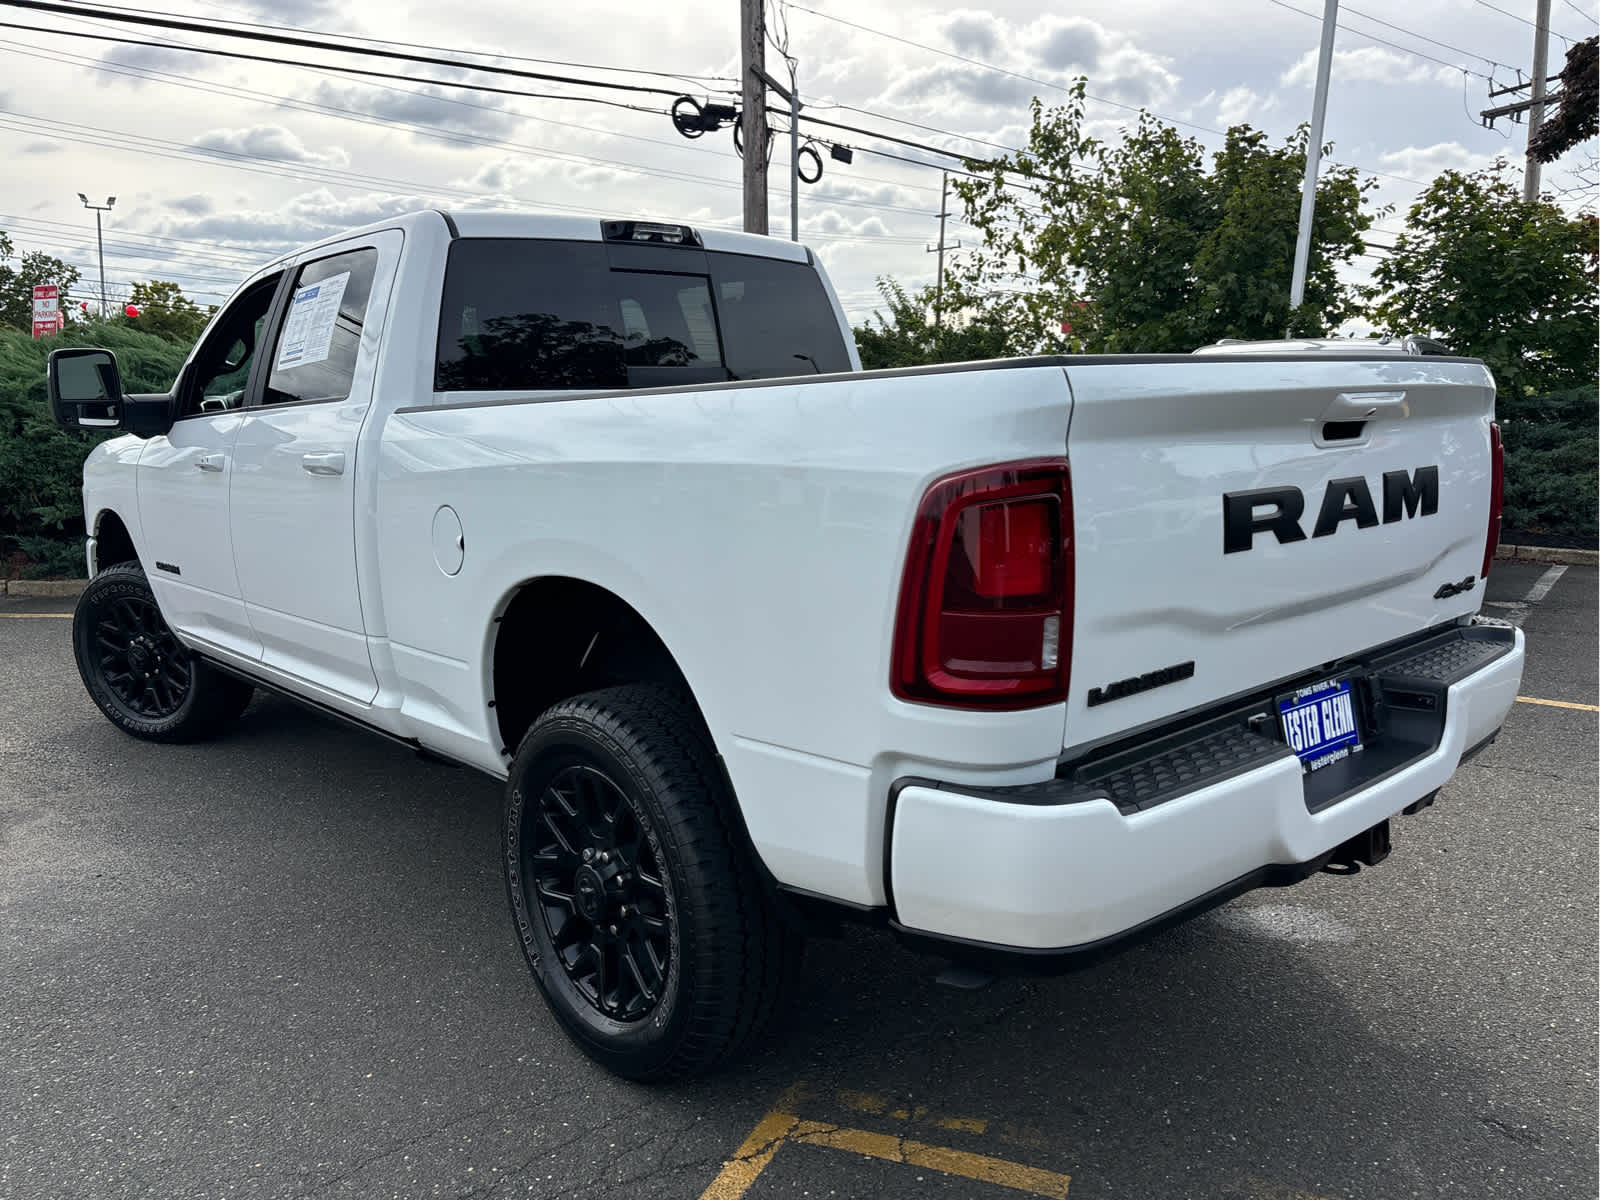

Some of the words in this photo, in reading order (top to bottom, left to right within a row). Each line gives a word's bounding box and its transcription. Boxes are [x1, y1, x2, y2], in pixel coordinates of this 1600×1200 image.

[34, 311, 57, 319] PARKING
[1223, 465, 1439, 554] RAM
[1321, 693, 1355, 741] GLENN
